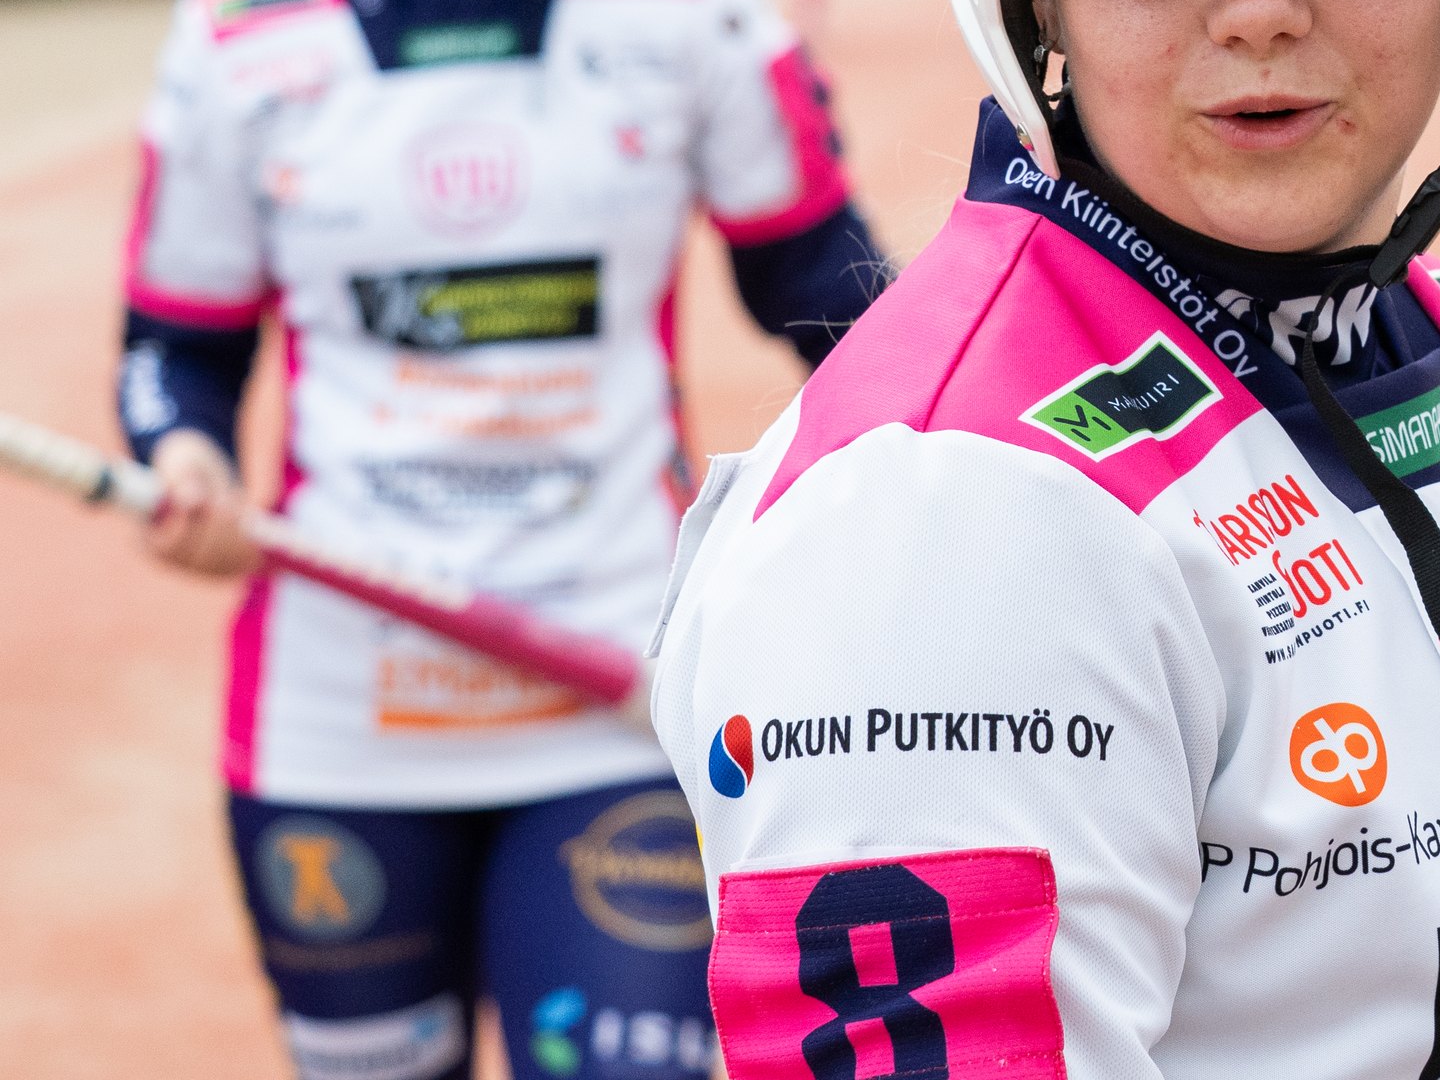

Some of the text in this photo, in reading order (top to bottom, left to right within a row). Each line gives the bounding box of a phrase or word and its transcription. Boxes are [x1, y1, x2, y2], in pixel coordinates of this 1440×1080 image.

[1061, 181, 1219, 333] Kiinteistöt
[1213, 329, 1259, 379] Oy
[761, 716, 852, 763] OKUN
[867, 708, 1055, 755] PUTKITYÖ
[795, 862, 956, 1080] 8
